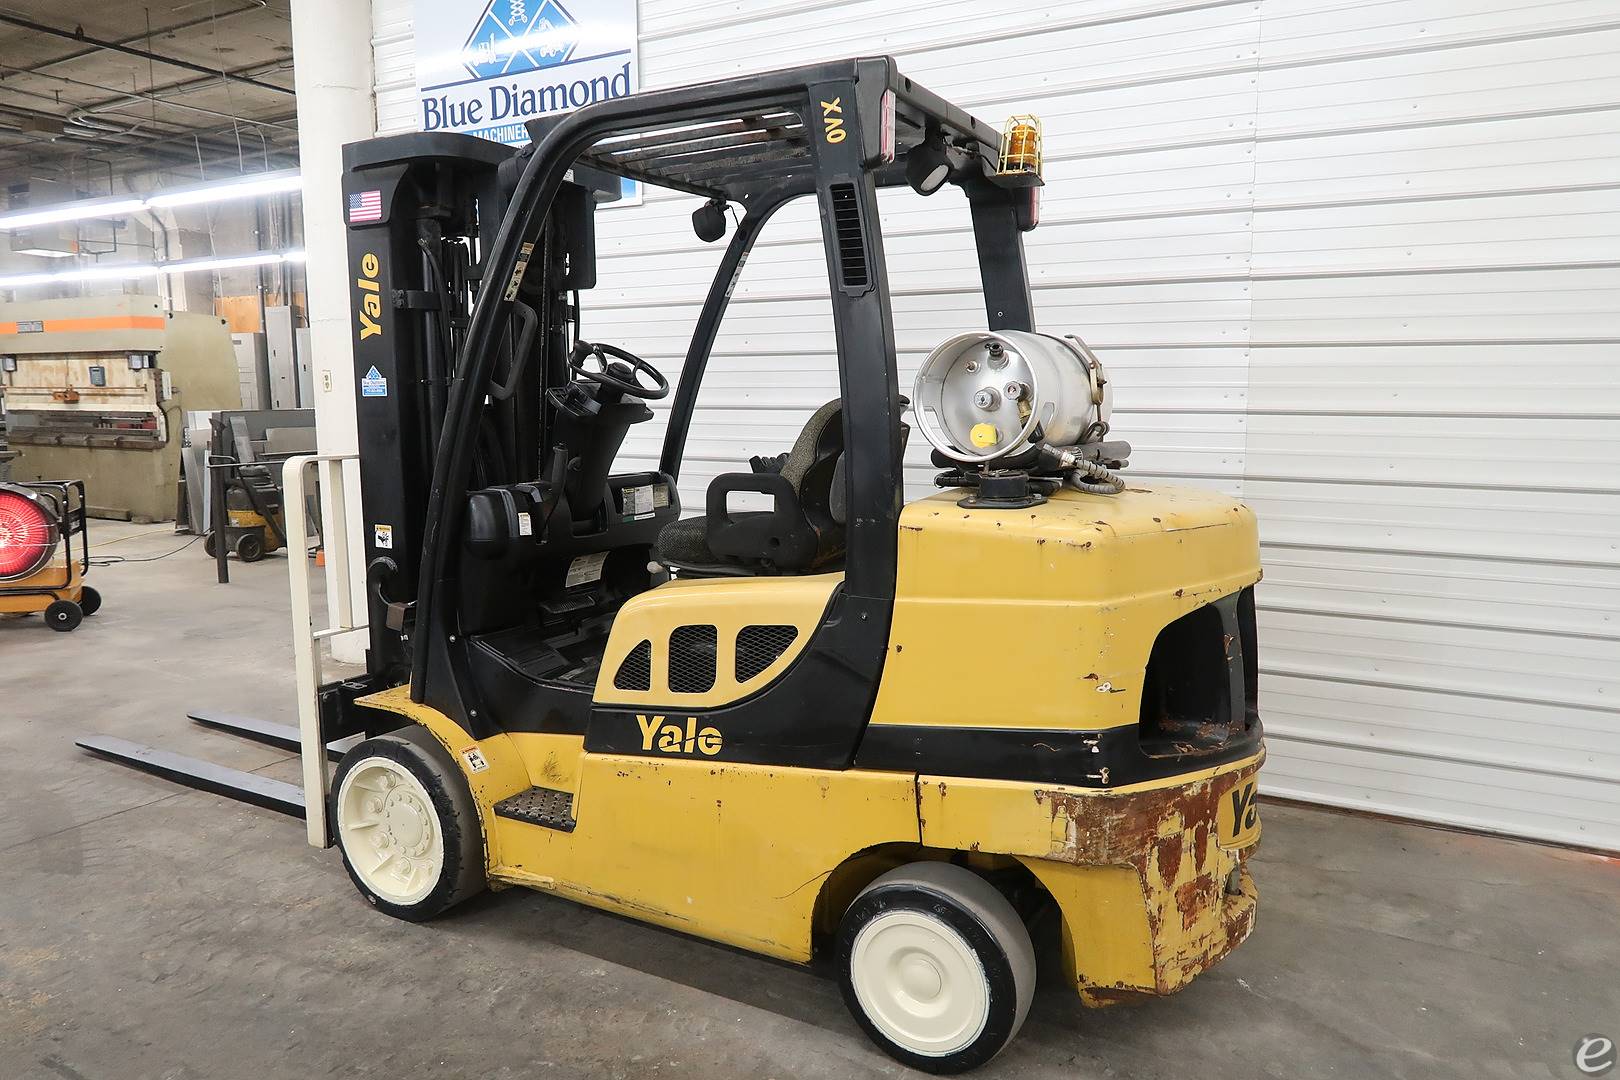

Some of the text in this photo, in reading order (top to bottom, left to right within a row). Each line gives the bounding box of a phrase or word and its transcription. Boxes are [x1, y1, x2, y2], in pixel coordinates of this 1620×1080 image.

[421, 61, 631, 131] Blue Diamond
[357, 253, 382, 341] Yale
[635, 714, 723, 756] Yale
